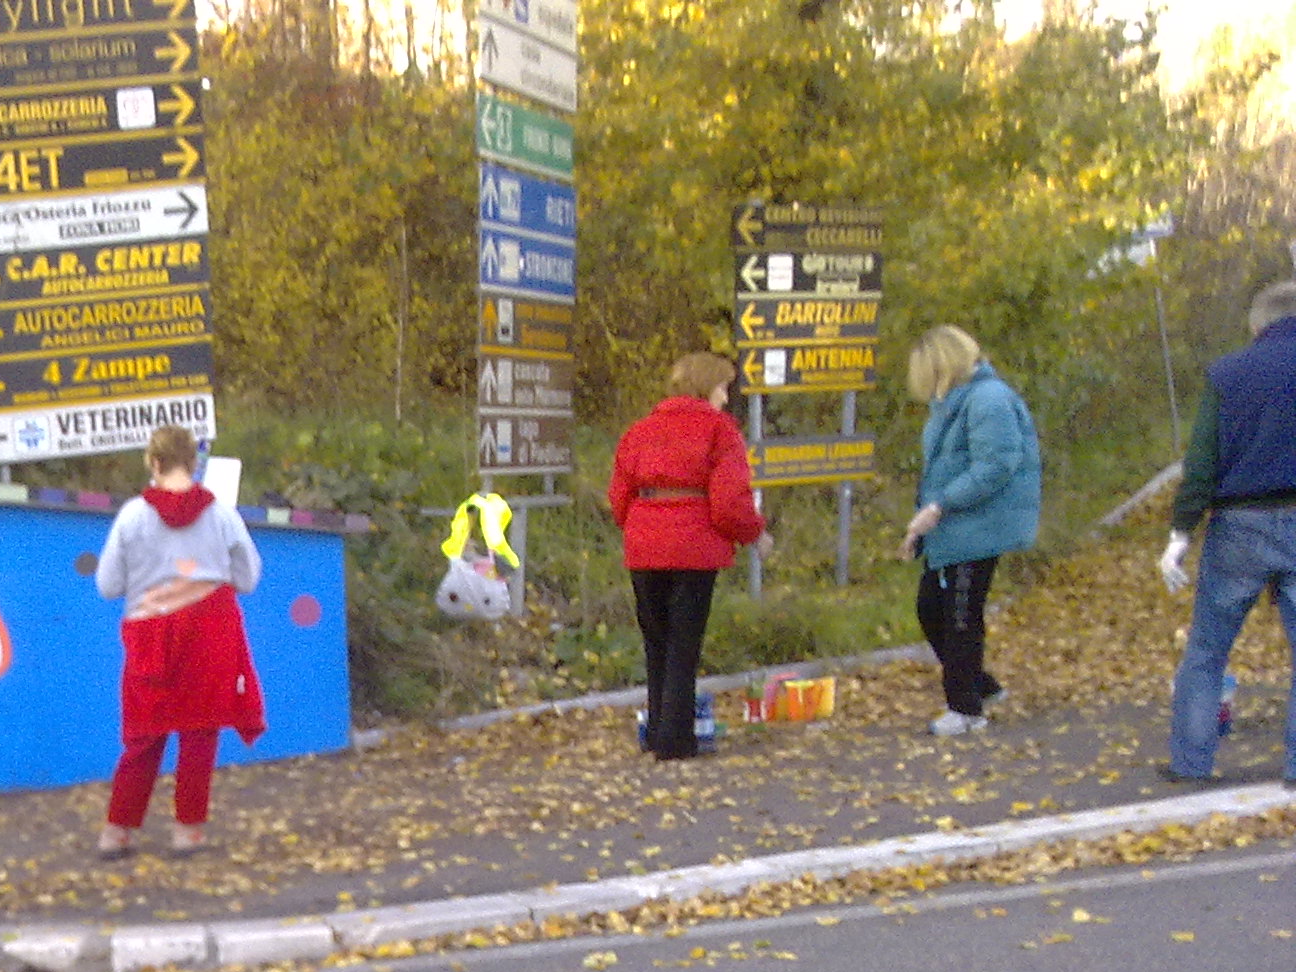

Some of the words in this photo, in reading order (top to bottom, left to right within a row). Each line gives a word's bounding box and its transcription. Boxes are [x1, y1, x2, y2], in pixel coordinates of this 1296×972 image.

[6, 252, 87, 282] C.A.R.
[95, 241, 202, 272] CENTER
[14, 295, 205, 334] AUTOCARROZZERIA
[133, 320, 205, 339] MAURO
[775, 301, 879, 327] BARTOLLINI
[43, 359, 63, 385] 4
[71, 354, 172, 383] Zampe
[791, 345, 876, 371] ANTENNA
[56, 398, 208, 436] VETERINARIO
